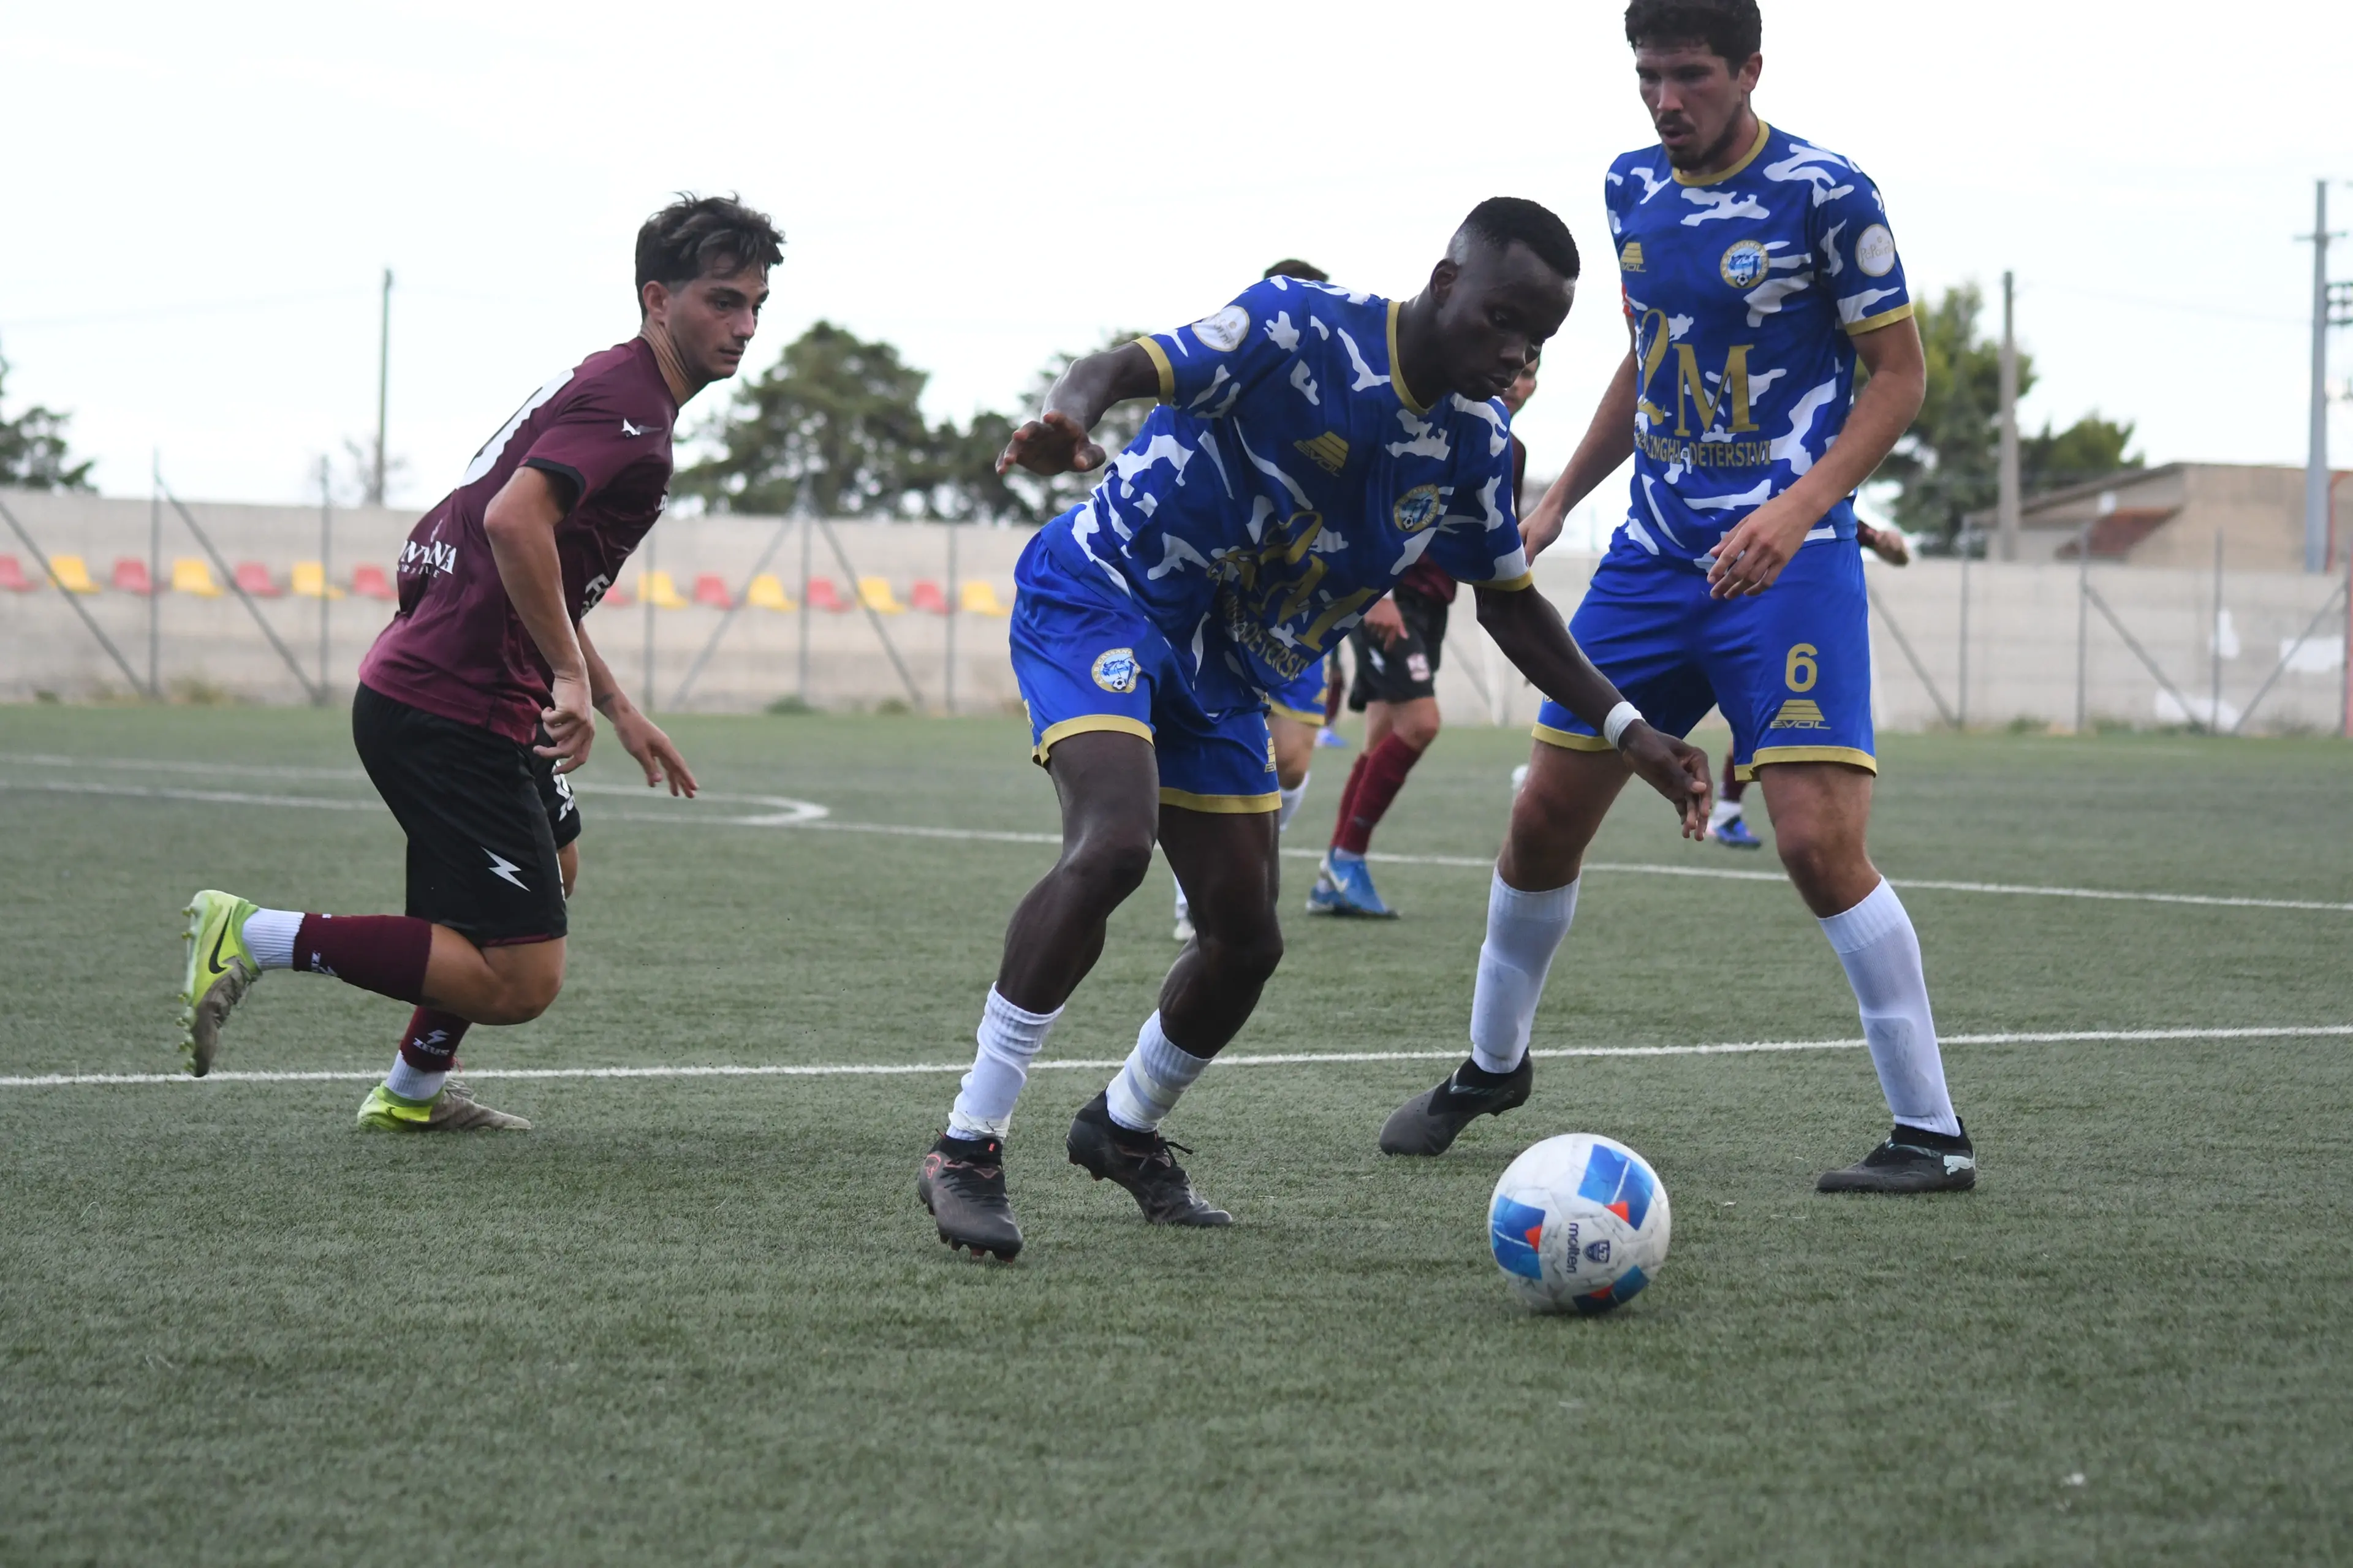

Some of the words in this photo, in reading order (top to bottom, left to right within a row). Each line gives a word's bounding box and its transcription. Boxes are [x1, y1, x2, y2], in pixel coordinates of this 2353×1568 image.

[1689, 440, 1771, 467] DETERSIVI
[1785, 643, 1817, 692] 6
[1770, 720, 1831, 729] EVOL
[413, 1037, 450, 1056] ZEUS
[1566, 1222, 1580, 1273] molten
